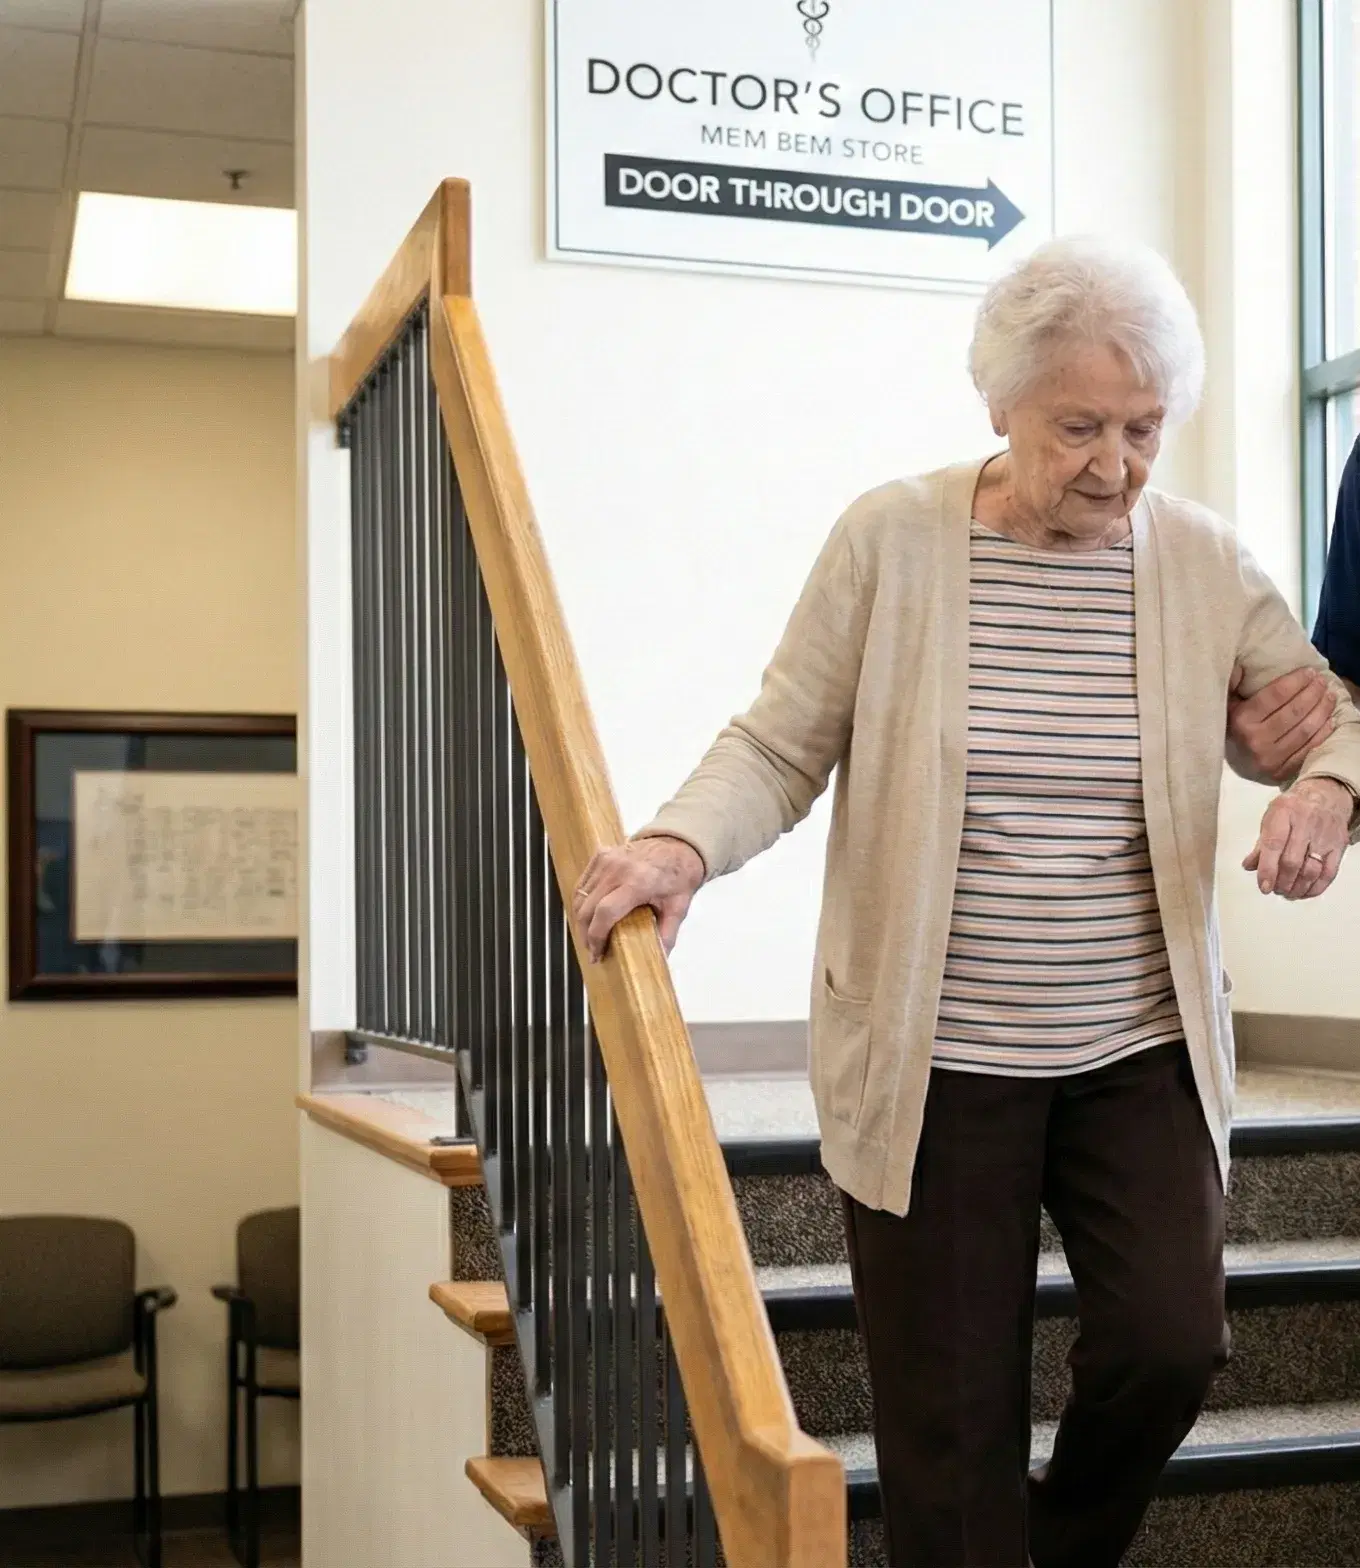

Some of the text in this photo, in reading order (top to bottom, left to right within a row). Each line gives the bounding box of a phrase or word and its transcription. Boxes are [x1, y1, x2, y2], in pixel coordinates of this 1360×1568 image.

[586, 58, 1025, 137] DOCTOR'S OFFICE
[700, 125, 925, 165] MEM BEM STORE
[618, 167, 996, 229] DOOR THROUGH DOOR
